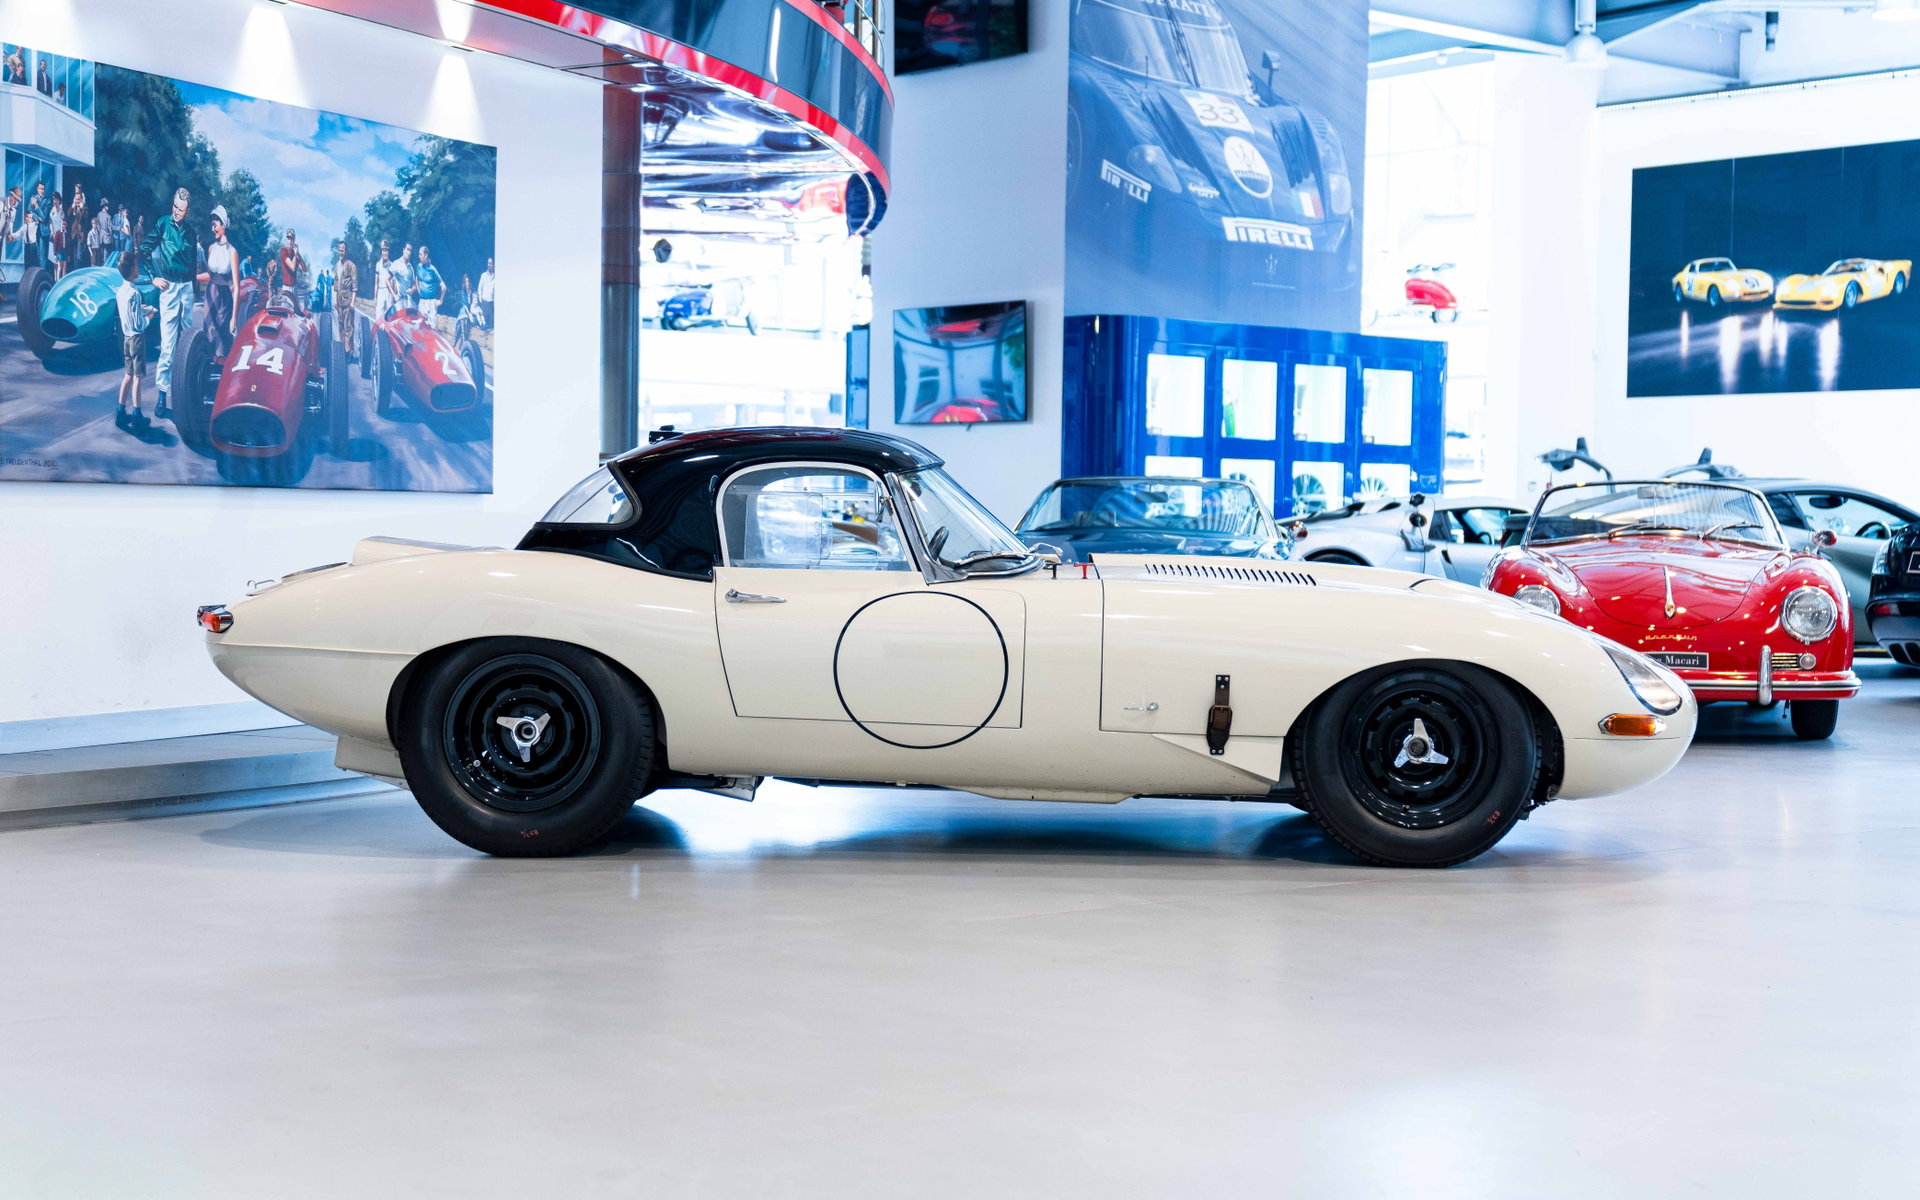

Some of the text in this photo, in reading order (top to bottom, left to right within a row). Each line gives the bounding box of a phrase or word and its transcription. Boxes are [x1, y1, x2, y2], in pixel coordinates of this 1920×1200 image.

[1199, 103, 1239, 125] 33
[1101, 159, 1152, 203] PIRLLI
[1222, 216, 1314, 251] PIRELLI
[69, 291, 98, 318] 18
[231, 345, 284, 376] 14
[434, 350, 458, 376] 2
[1665, 655, 1700, 665] Macari
